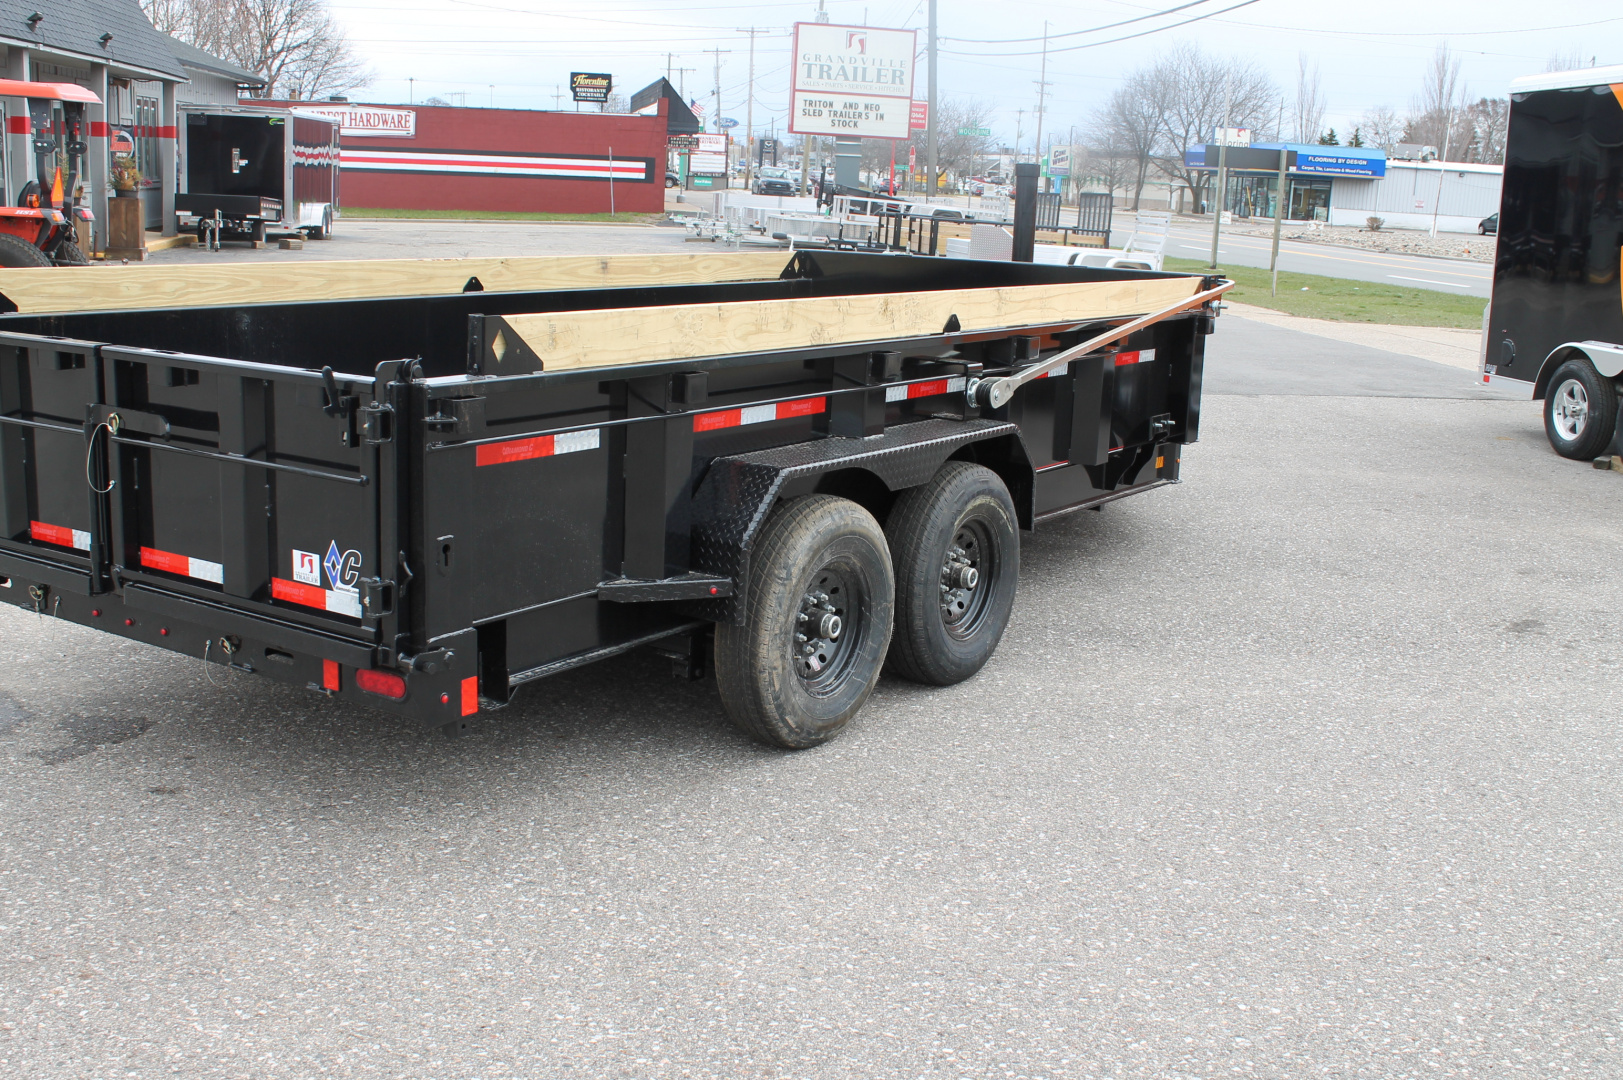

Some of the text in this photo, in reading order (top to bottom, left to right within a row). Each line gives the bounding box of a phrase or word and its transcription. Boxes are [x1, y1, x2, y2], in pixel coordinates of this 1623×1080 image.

[802, 53, 907, 68] GRANDVILLE
[802, 62, 905, 85] TRAILER
[572, 74, 609, 87] Florentine
[801, 80, 820, 88] SALES
[824, 82, 844, 90] PARTS
[878, 85, 905, 93] HITCHES
[803, 99, 881, 112] TRITON AND NEO
[349, 111, 411, 129] HARDWARE
[802, 108, 885, 121] SLED TRAILERS IN
[831, 119, 859, 129] STOCK
[1308, 156, 1337, 164] FLOORING
[1345, 158, 1368, 166] DESIGN
